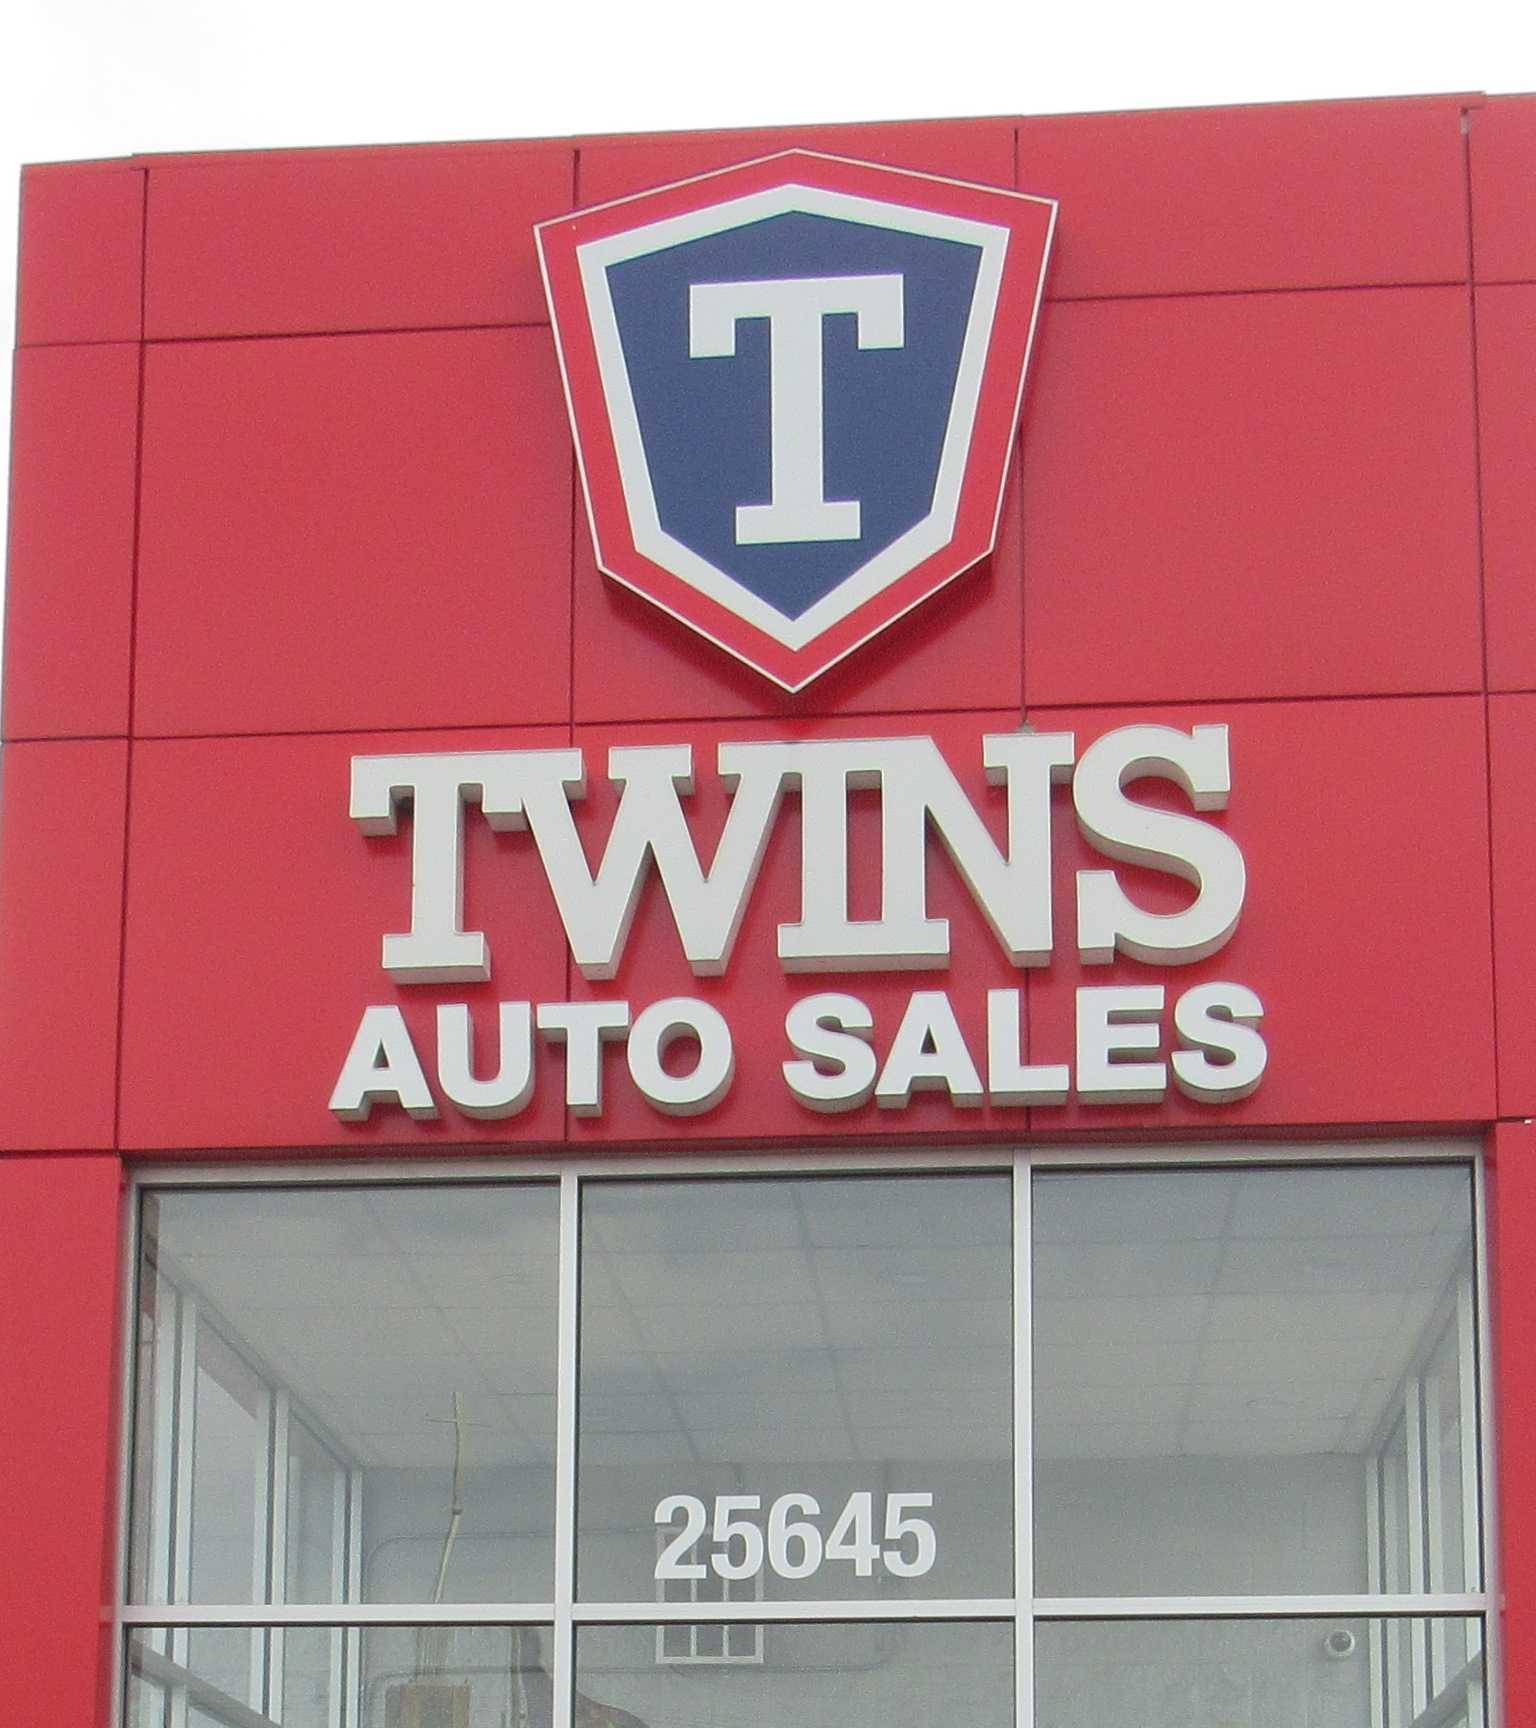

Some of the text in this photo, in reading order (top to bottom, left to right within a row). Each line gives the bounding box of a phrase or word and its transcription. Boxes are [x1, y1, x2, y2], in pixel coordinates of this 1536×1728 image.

[689, 274, 906, 546] T
[349, 723, 1247, 984] TWINS
[327, 981, 1268, 1122] AUTO SALES
[653, 1492, 937, 1580] 25645
